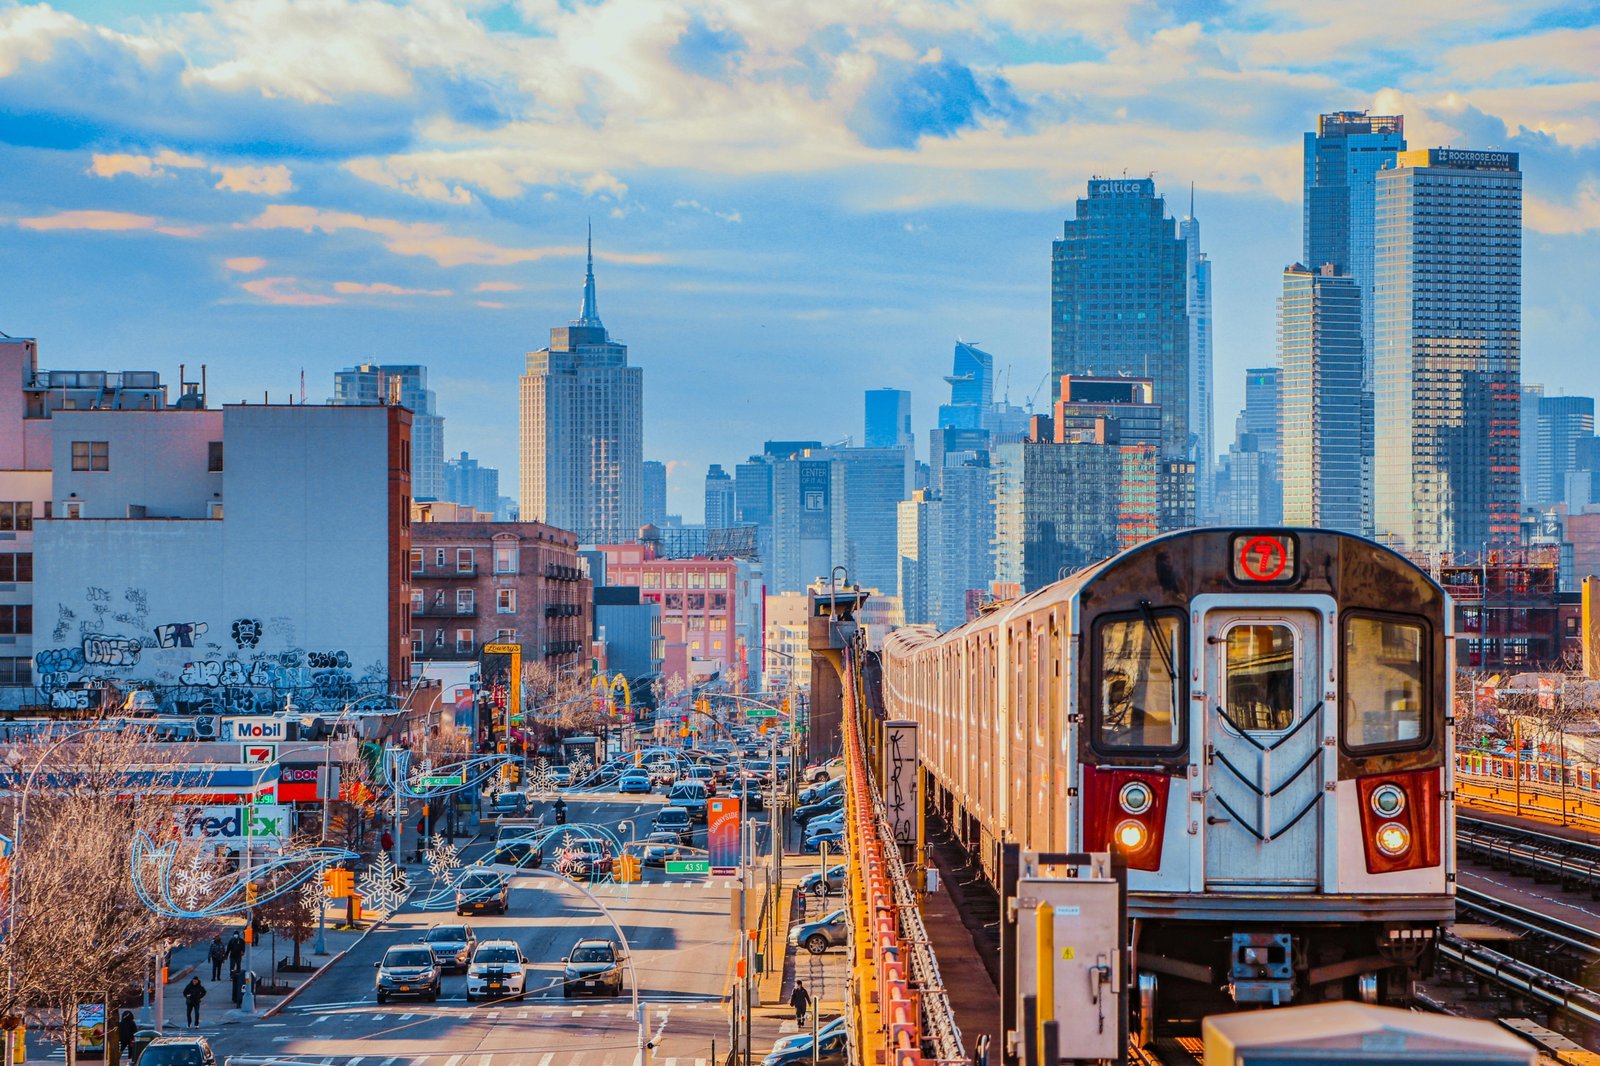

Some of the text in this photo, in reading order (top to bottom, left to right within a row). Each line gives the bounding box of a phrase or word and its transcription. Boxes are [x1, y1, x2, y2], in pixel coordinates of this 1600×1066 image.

[1448, 151, 1509, 162] ROCKROSE.COM
[1099, 181, 1141, 193] altice
[801, 468, 827, 477] CENTER
[1255, 545, 1272, 573] 7
[238, 722, 281, 737] Mobil
[708, 811, 739, 834] SUNNYSIDE
[684, 863, 693, 871] 43
